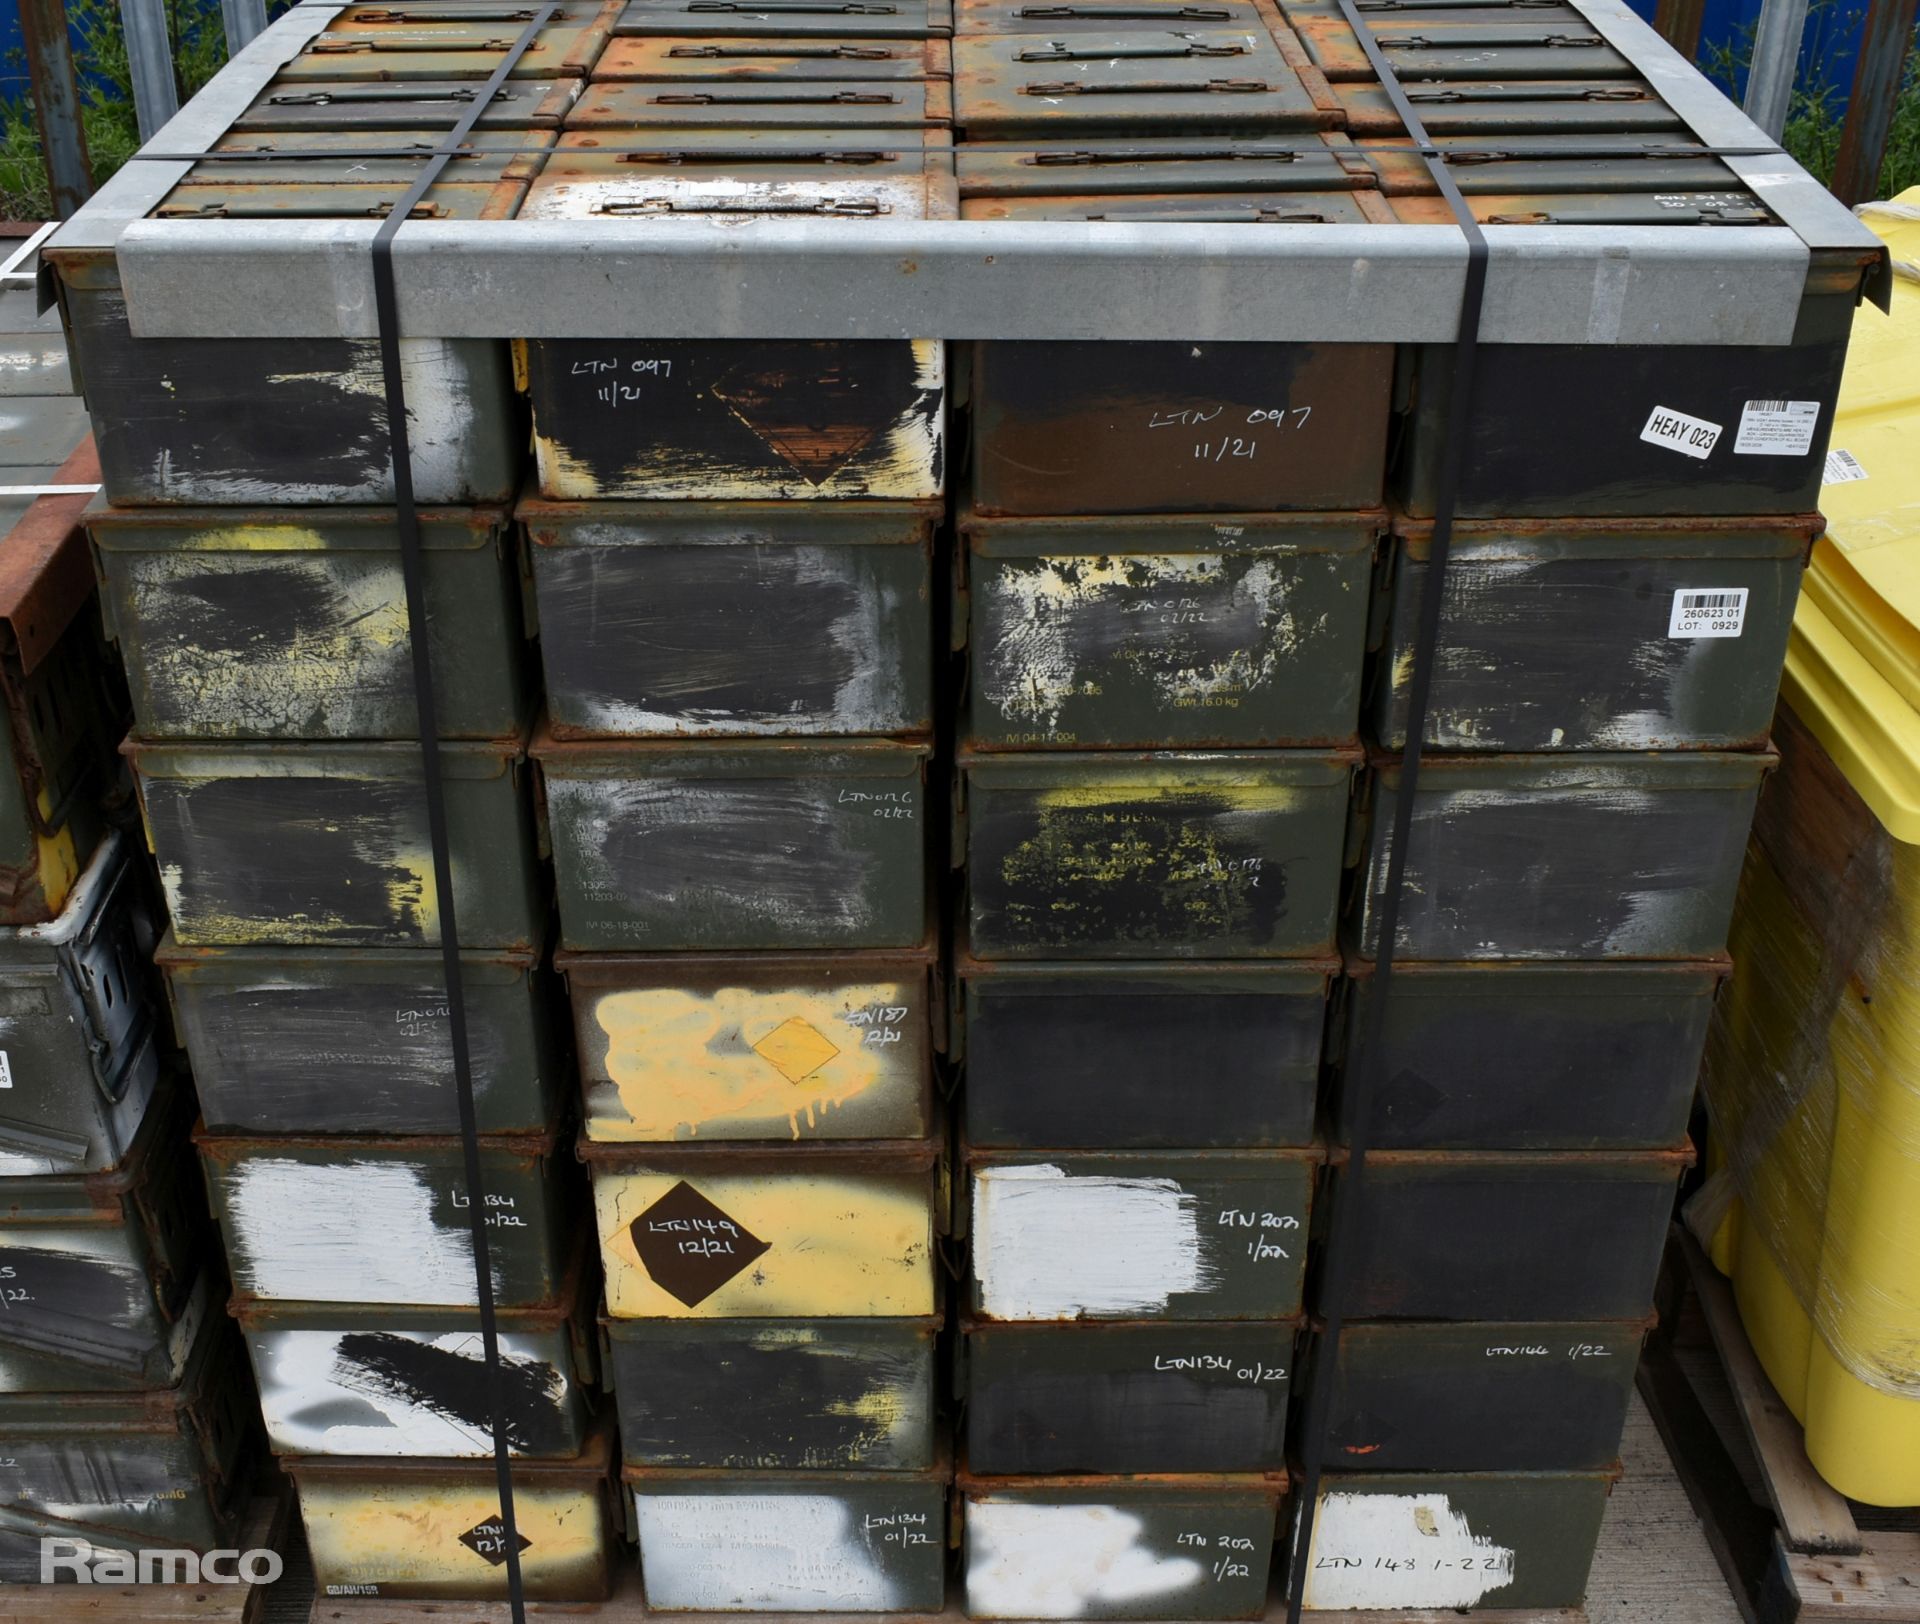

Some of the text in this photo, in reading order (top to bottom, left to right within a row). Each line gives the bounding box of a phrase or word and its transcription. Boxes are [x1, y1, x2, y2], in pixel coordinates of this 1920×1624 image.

[571, 358, 672, 377] LTN 097
[598, 381, 641, 408] 11/21
[1149, 406, 1312, 429] LTN 097
[1650, 414, 1716, 449] HEAY 023
[1193, 438, 1256, 461] 11/21
[1684, 609, 1740, 618] 260623 01
[1677, 621, 1738, 630] LOT: 0929
[649, 1218, 739, 1238] LTN149
[1218, 1209, 1256, 1227] LTN
[678, 1238, 735, 1258] 12/21
[1247, 1234, 1290, 1262] 1/22
[1568, 1343, 1613, 1360] 1/22
[1154, 1355, 1288, 1384] LTN134 01/22
[866, 1514, 928, 1528] LTN134
[884, 1527, 939, 1548] 01/22
[1176, 1533, 1255, 1551] LTN 202
[1213, 1556, 1250, 1582] 1/22
[1315, 1556, 1362, 1570] LTN
[1374, 1557, 1416, 1572] 148
